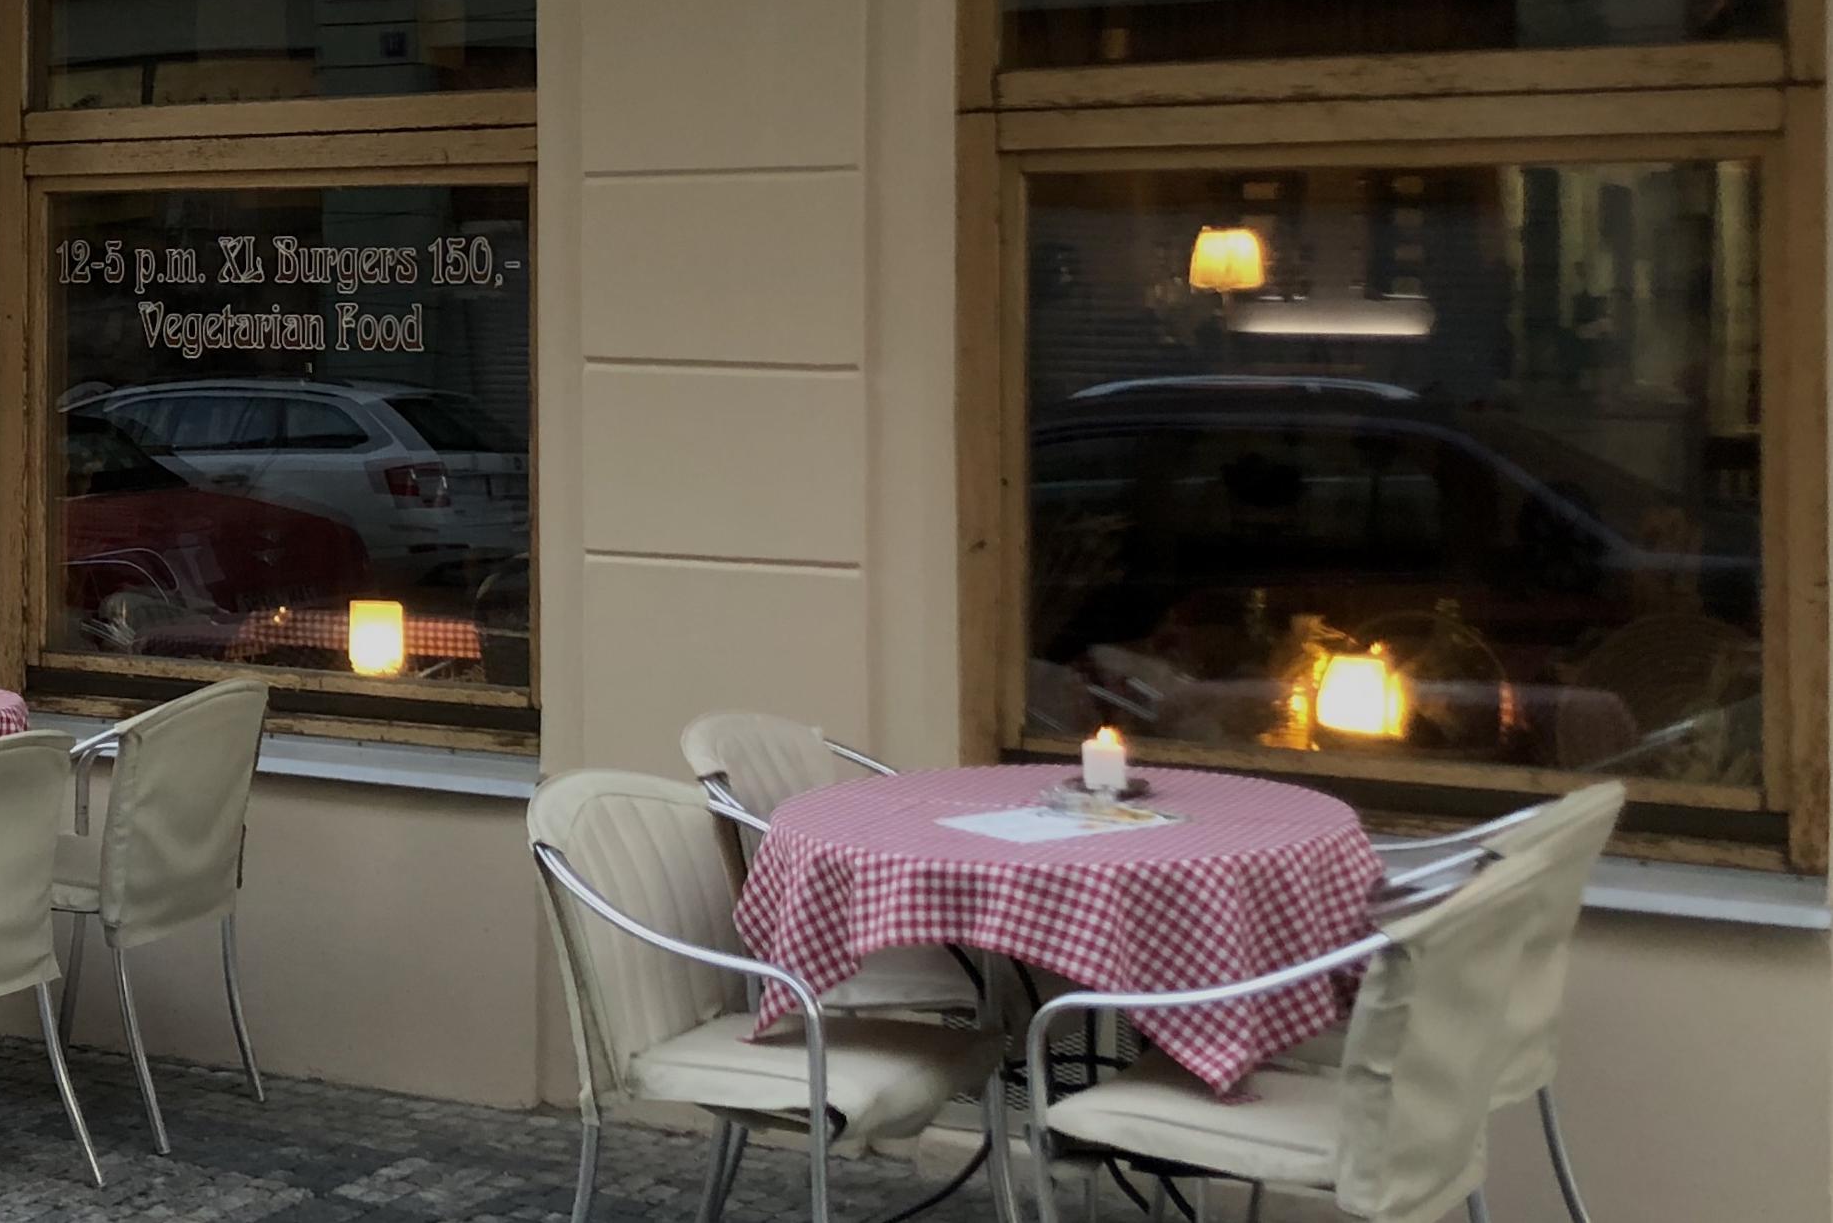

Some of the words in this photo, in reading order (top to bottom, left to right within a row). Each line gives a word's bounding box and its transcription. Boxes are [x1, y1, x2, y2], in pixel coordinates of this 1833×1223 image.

[55, 238, 125, 285] 12-5
[133, 241, 207, 295] p.m.
[216, 235, 265, 285] XL
[273, 235, 419, 295] Burgers
[427, 235, 522, 290] 150,-
[137, 300, 326, 360] Vegetarian
[334, 302, 425, 353] Food
